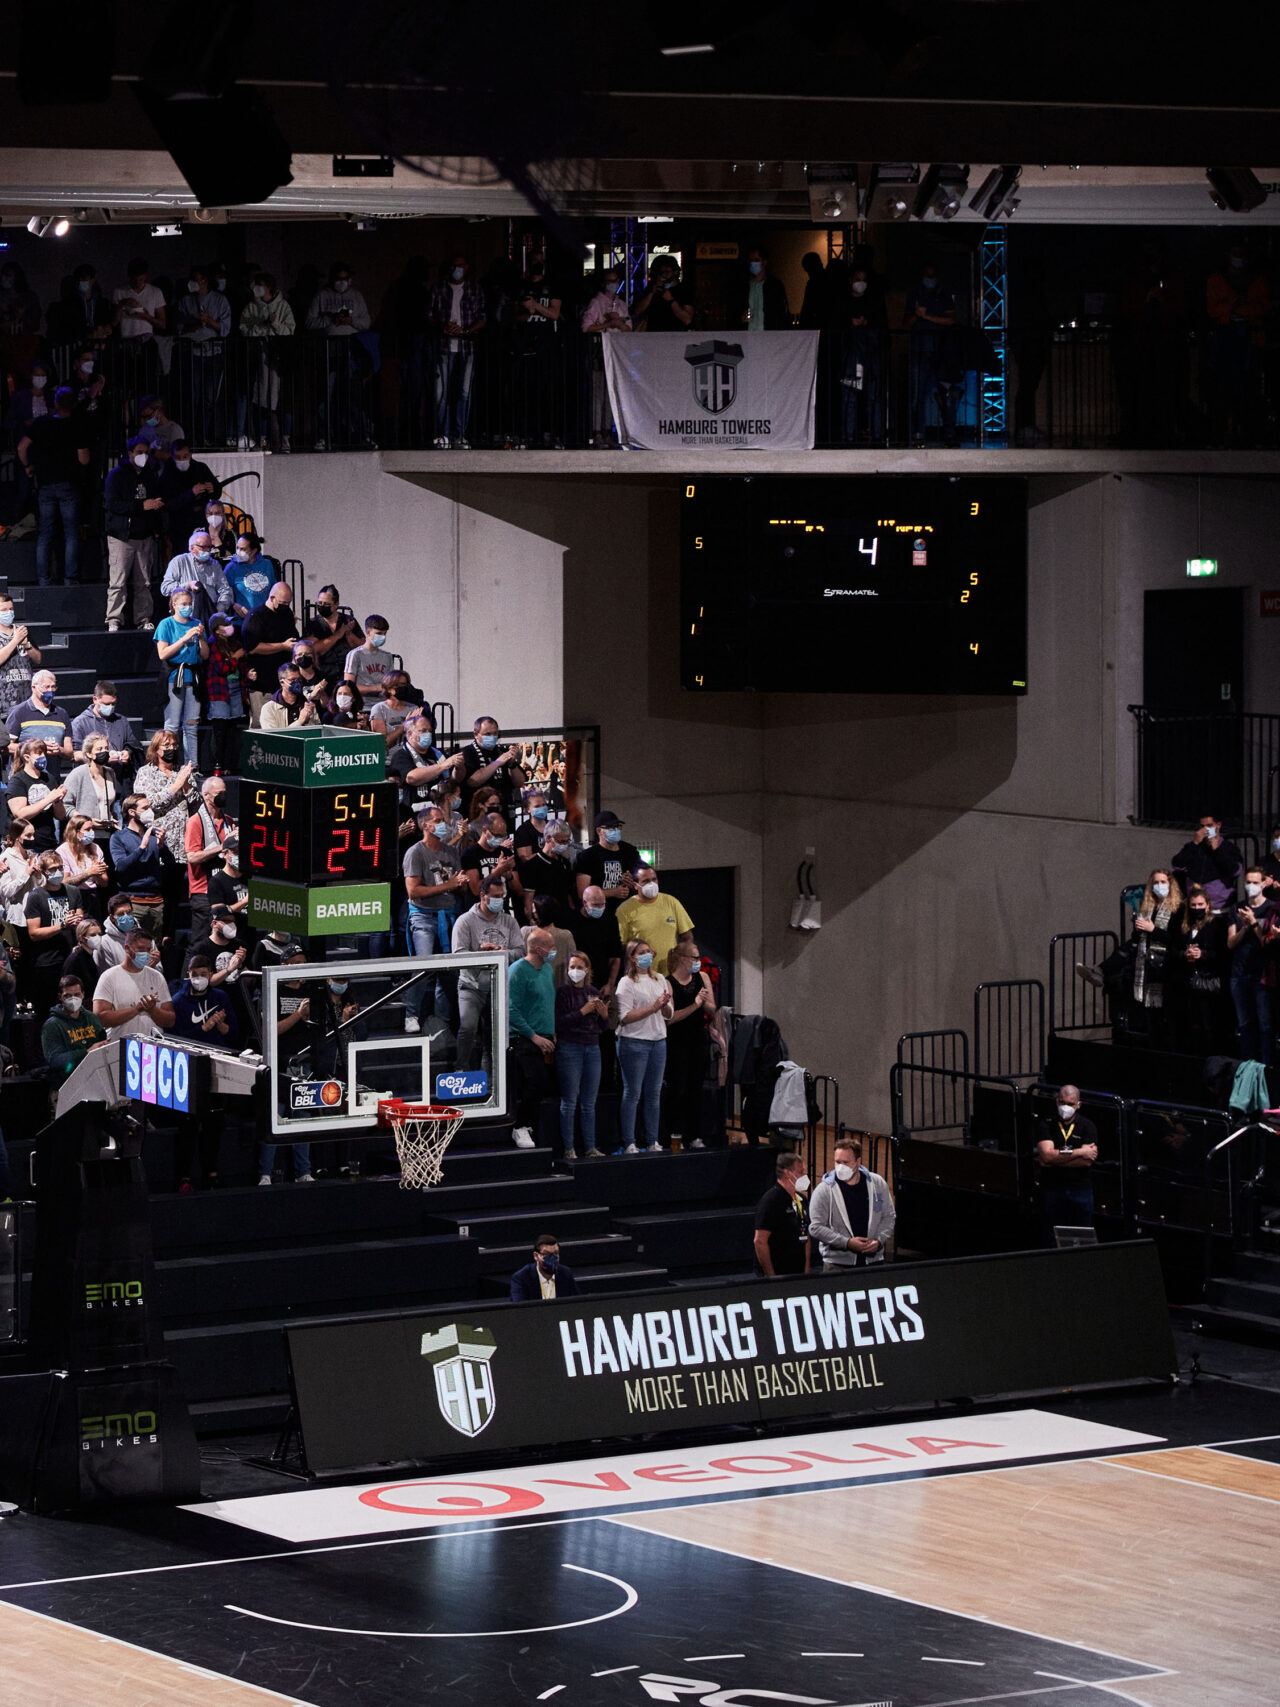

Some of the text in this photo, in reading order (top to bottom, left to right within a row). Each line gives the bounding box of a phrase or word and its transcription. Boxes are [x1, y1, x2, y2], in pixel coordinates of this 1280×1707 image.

[659, 420, 771, 435] HAMBURG TOWERS
[681, 436, 748, 445] MORE THAN BASKETBALL
[686, 485, 695, 498] 0
[969, 502, 979, 515] 3
[695, 536, 703, 549] 5
[858, 537, 878, 566] 4
[970, 573, 978, 586] 5
[824, 588, 879, 598] STRAMATEL
[960, 590, 969, 603] 2
[970, 643, 979, 655] 4
[366, 663, 387, 675] NIKE
[695, 675, 704, 686] 4
[265, 751, 300, 769] HOLSTEN
[334, 752, 380, 768] HOLSTEN
[255, 790, 286, 819] 5.4
[334, 793, 374, 822] 5.4
[250, 824, 290, 869] 24
[327, 827, 381, 873] 24
[480, 857, 499, 866] HAMBU
[253, 896, 301, 918] BARMER
[316, 901, 382, 919] BARMER
[126, 1039, 190, 1103] saco
[451, 1083, 483, 1098] Credit
[294, 1095, 317, 1107] BBL
[86, 1298, 143, 1309] BIKES
[559, 1284, 925, 1377] HAMBURG TOWERS
[624, 1353, 884, 1414] MORE THAN BASKETBALL
[82, 1434, 157, 1450] BIKES
[539, 1435, 1006, 1493] VEOLIA
